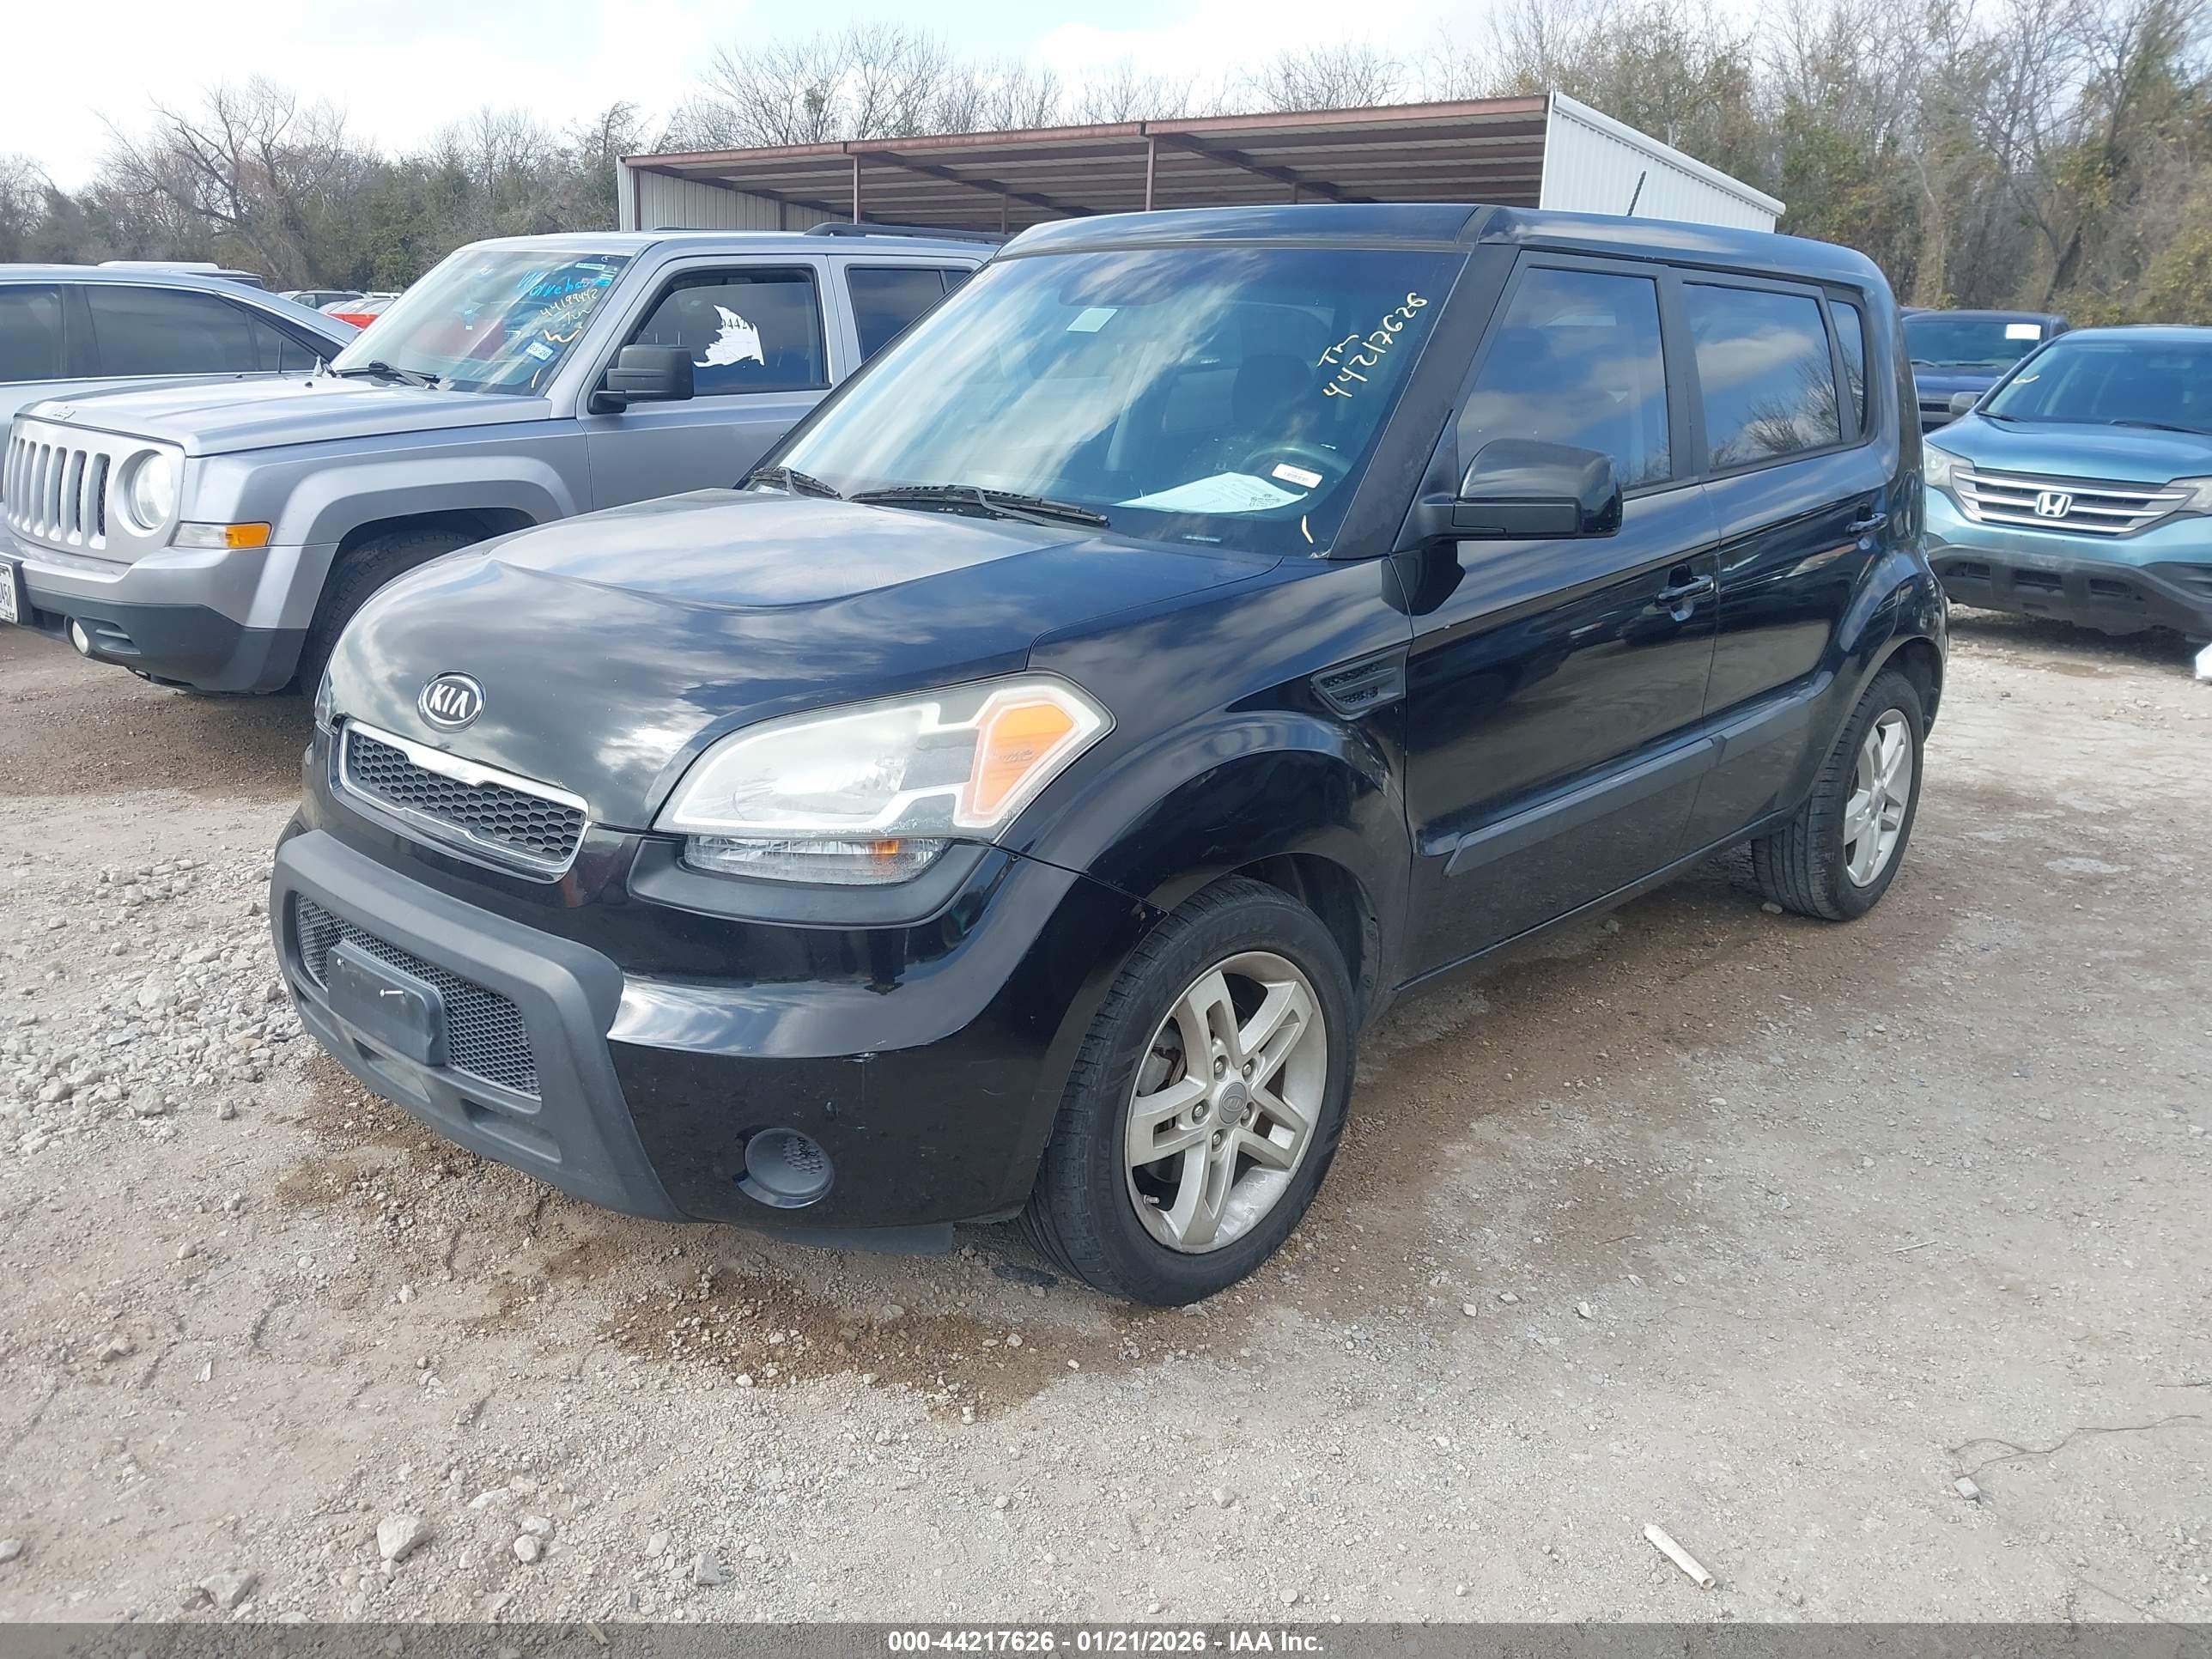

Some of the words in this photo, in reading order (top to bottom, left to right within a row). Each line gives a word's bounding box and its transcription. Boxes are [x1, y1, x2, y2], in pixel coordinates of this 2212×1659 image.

[539, 288, 599, 317] 44199442
[1322, 292, 1428, 398] 44217626
[0, 582, 13, 608] 458
[428, 684, 470, 719] KIA
